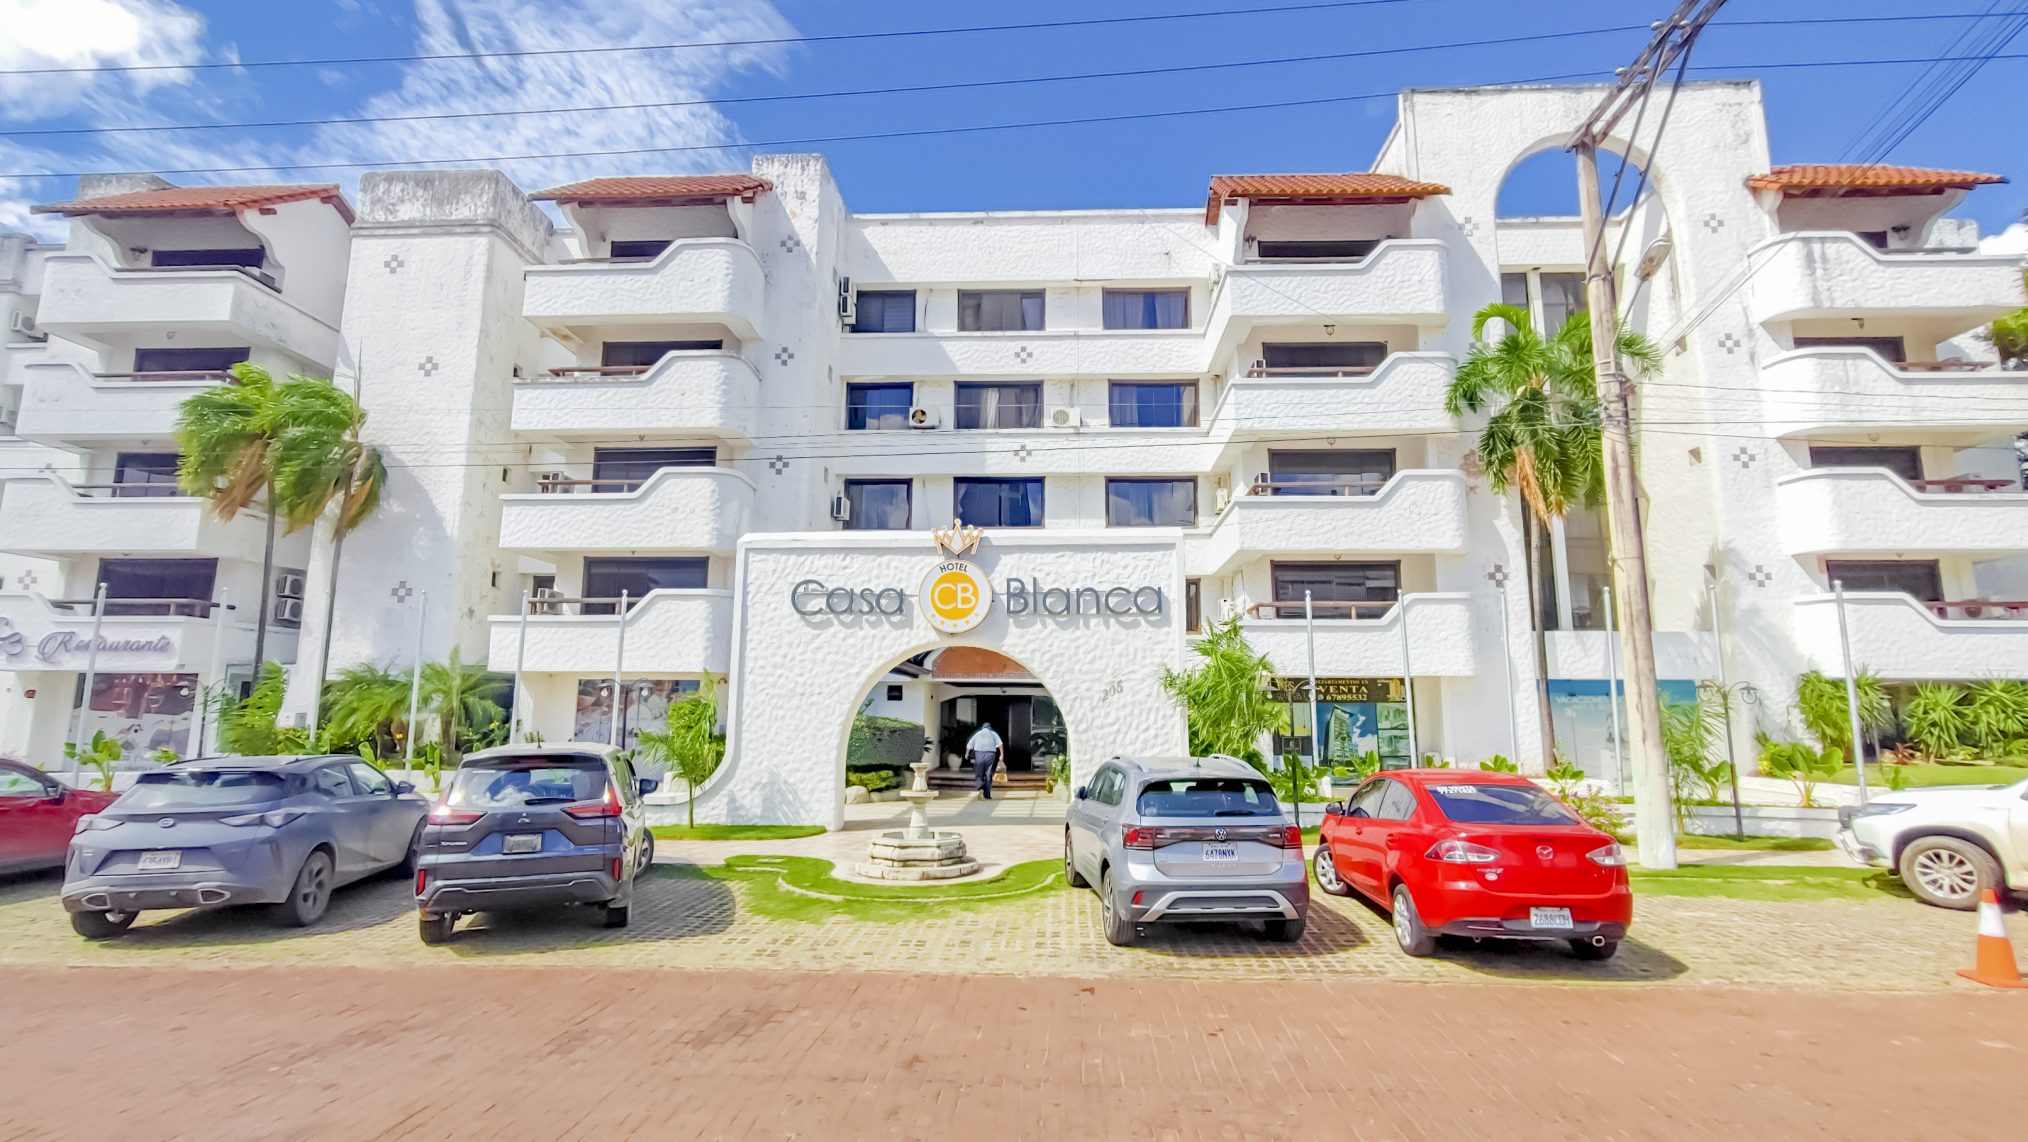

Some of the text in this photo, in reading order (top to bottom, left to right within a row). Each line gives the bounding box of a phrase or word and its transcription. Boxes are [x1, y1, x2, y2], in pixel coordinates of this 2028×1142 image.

[940, 563, 968, 573] HOTEL
[791, 577, 1163, 616] Casa CB Blanca
[35, 631, 172, 663] Resaurante
[1320, 685, 1369, 694] VENTA
